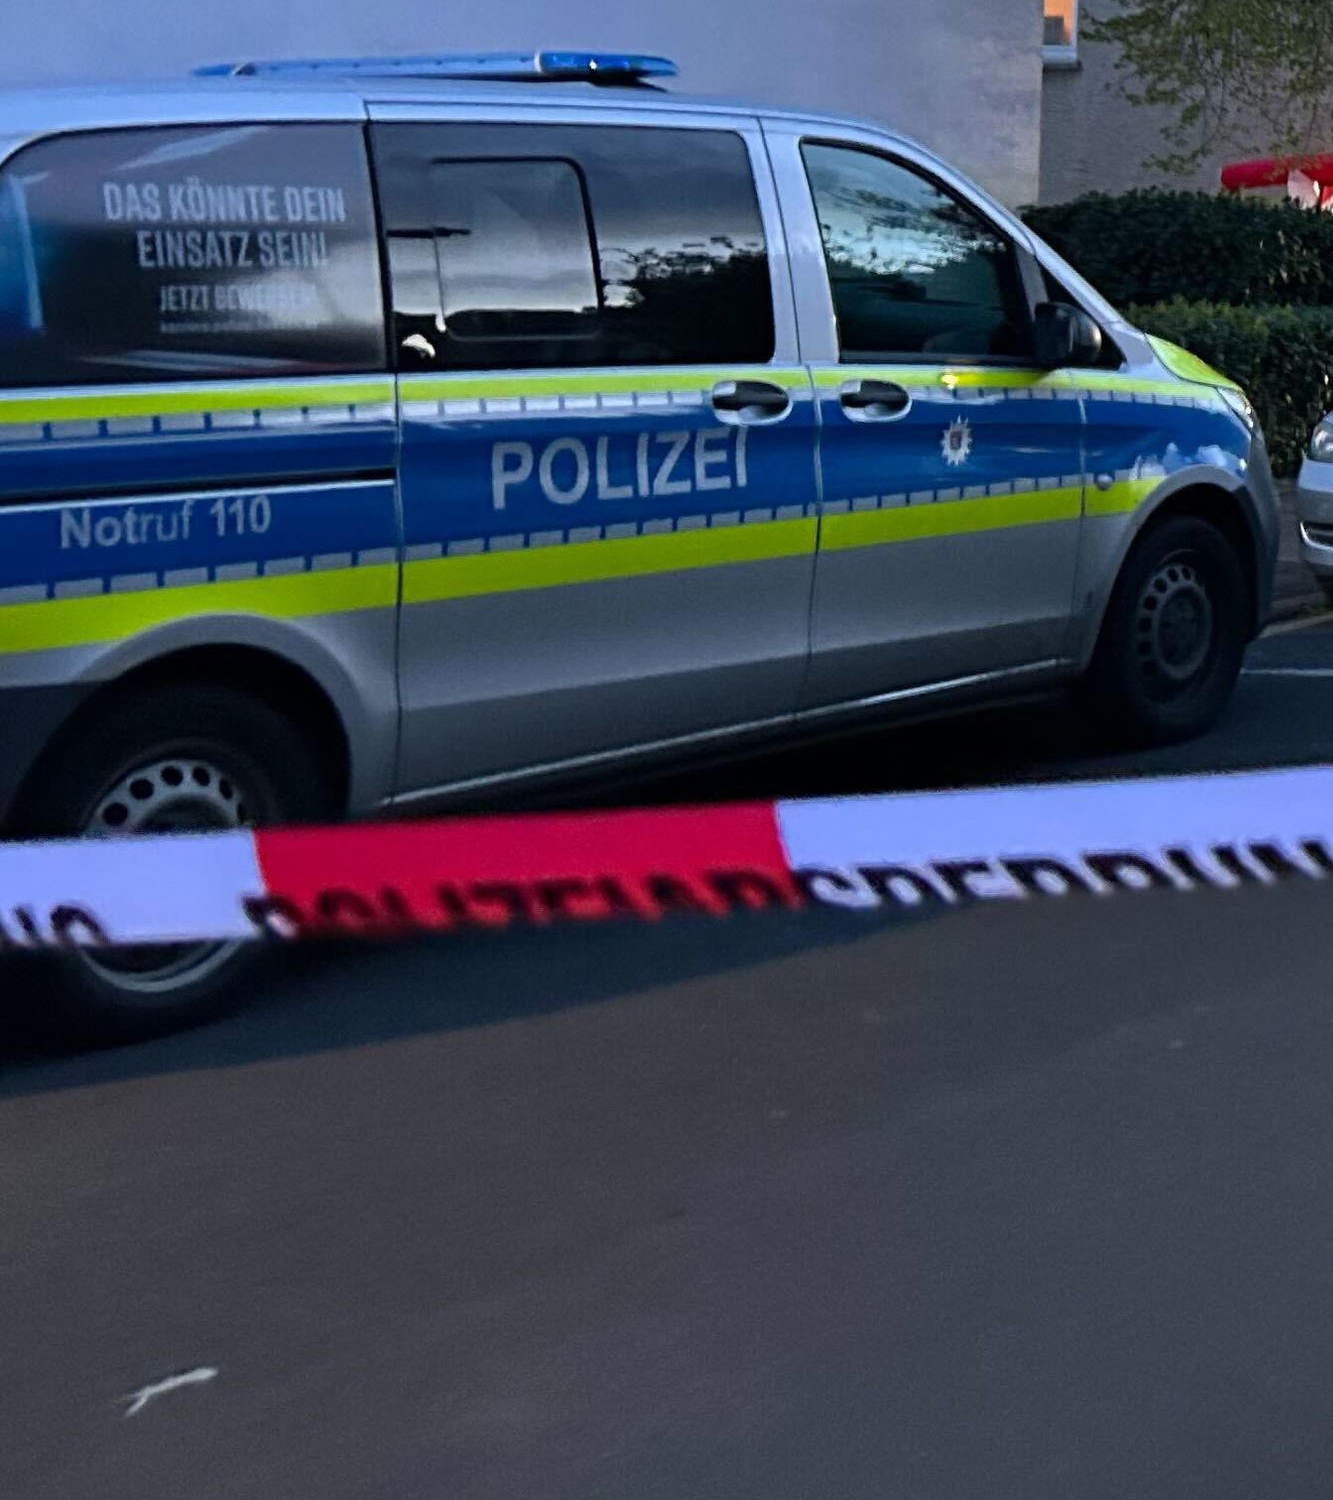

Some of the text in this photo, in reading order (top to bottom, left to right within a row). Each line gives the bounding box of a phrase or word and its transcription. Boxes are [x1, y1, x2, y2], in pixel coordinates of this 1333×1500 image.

[103, 175, 346, 223] DAS KÖNNTE DEIN
[136, 230, 328, 268] EINSATZ SEIN!
[160, 285, 210, 311] JETZT
[491, 425, 748, 510] POLIZEI
[60, 495, 272, 549] Notruf 110
